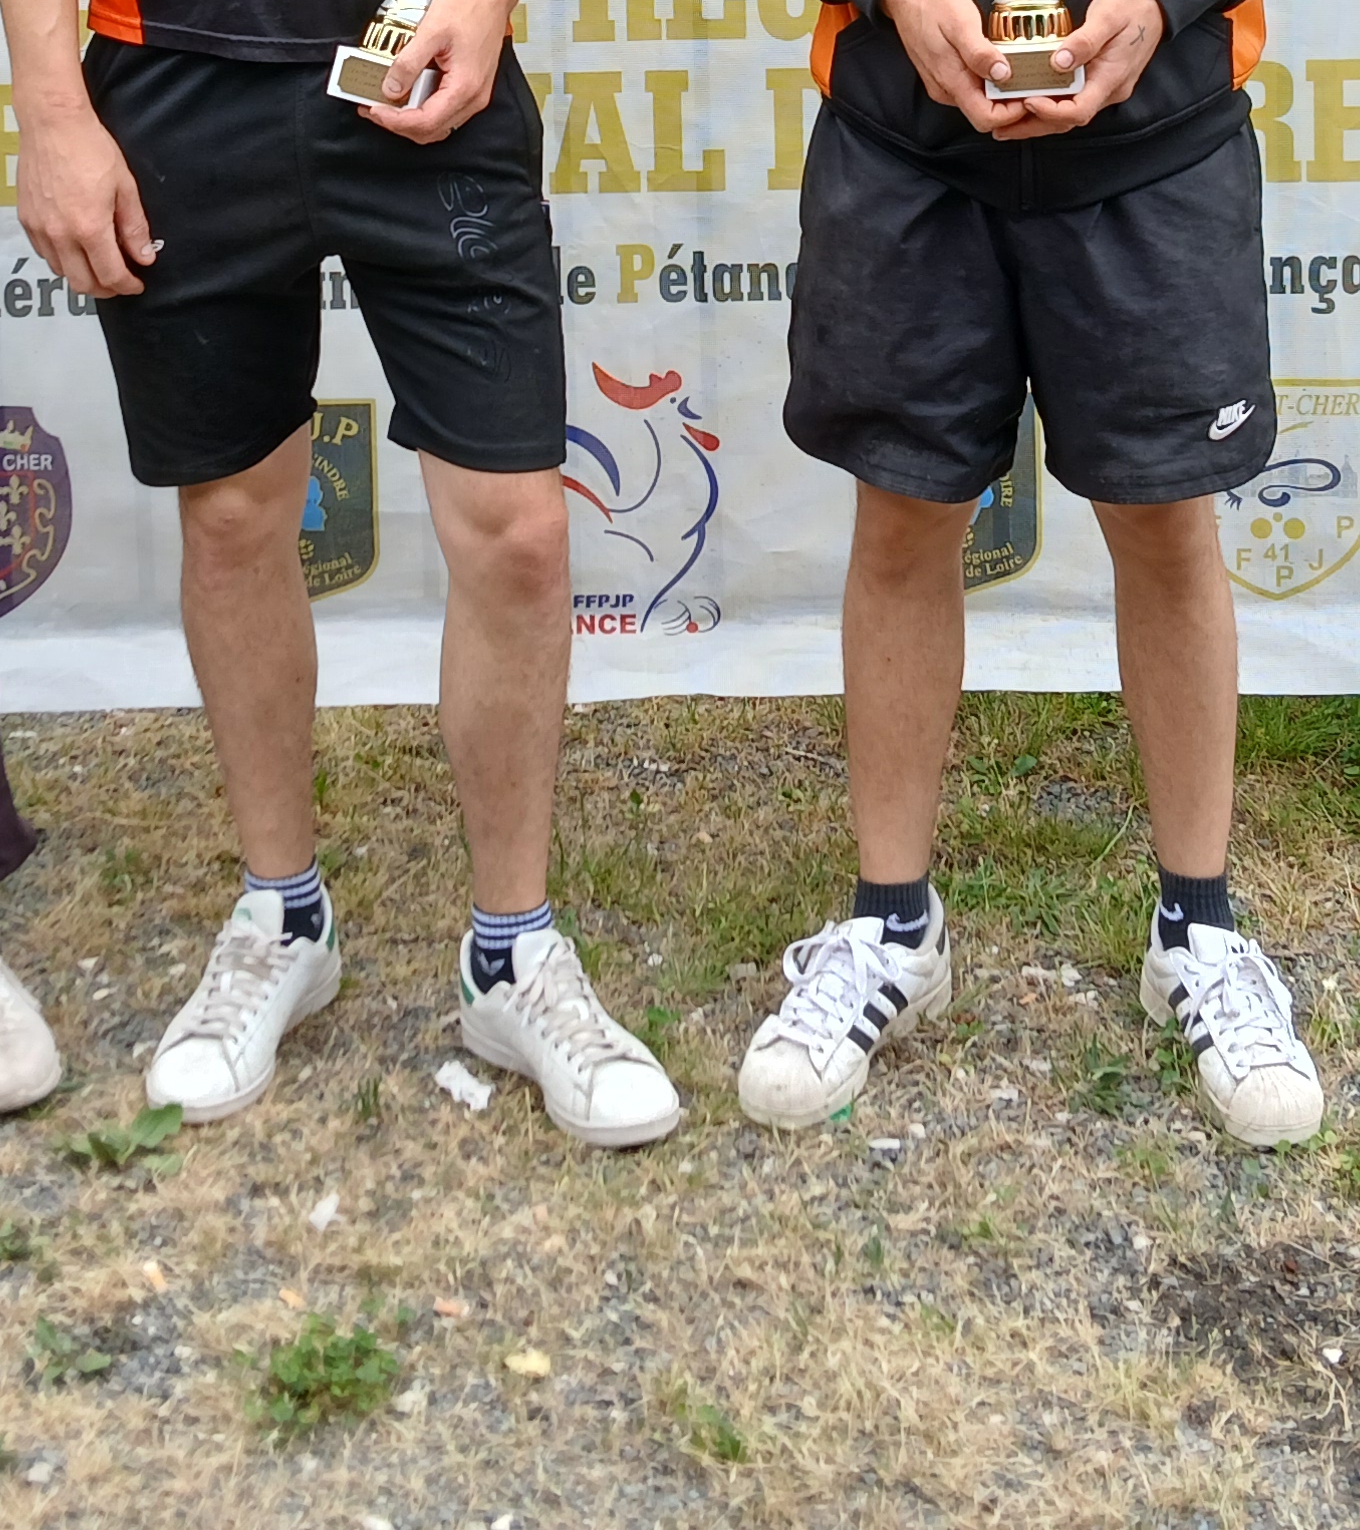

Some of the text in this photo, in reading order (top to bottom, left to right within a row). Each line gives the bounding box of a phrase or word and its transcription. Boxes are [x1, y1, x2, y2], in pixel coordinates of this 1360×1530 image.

[1216, 399, 1247, 427] NIKE
[2, 453, 52, 471] CHER
[573, 593, 635, 608] FFPJP
